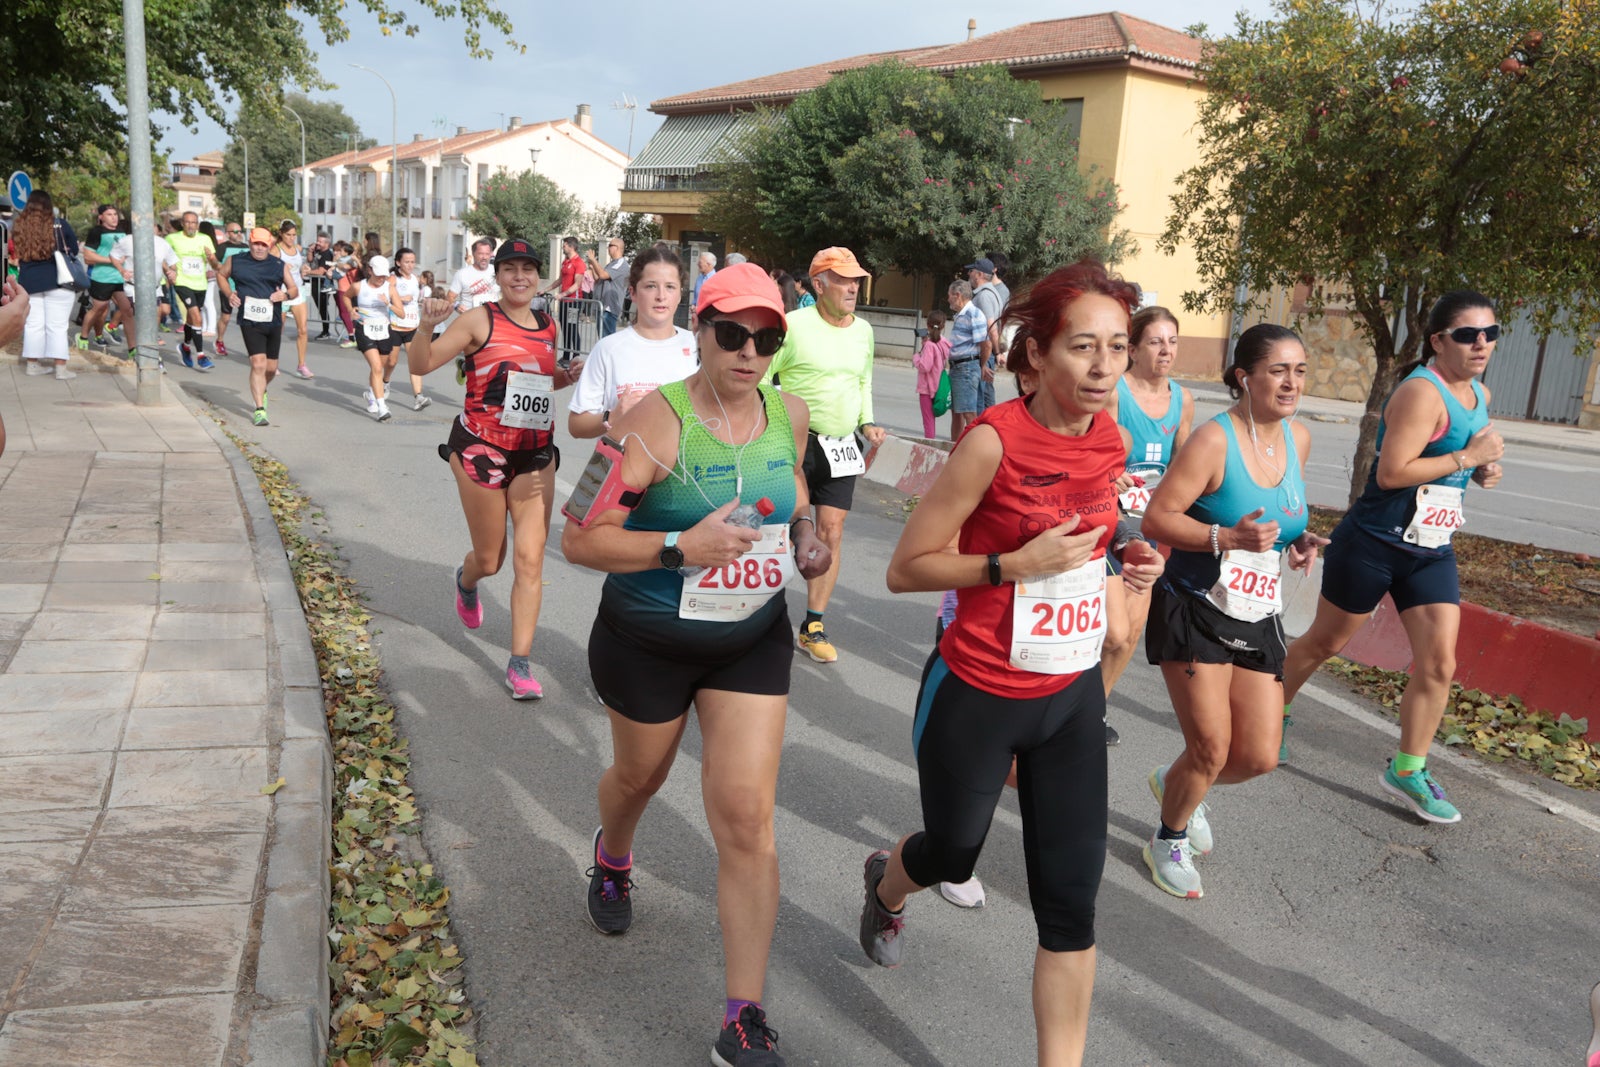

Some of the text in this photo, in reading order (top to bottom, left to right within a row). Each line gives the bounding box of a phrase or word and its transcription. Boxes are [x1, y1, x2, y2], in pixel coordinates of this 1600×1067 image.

[250, 306, 267, 314] 580
[369, 324, 384, 332] 768
[511, 393, 550, 414] 3069
[831, 446, 858, 463] 3100
[706, 464, 736, 473] olimpo
[1019, 487, 1110, 507] GRAN PREMIO
[1058, 501, 1112, 519] DE FONDO
[698, 558, 783, 590] 2086
[1227, 566, 1278, 600] 2035
[1030, 596, 1102, 637] 2062
